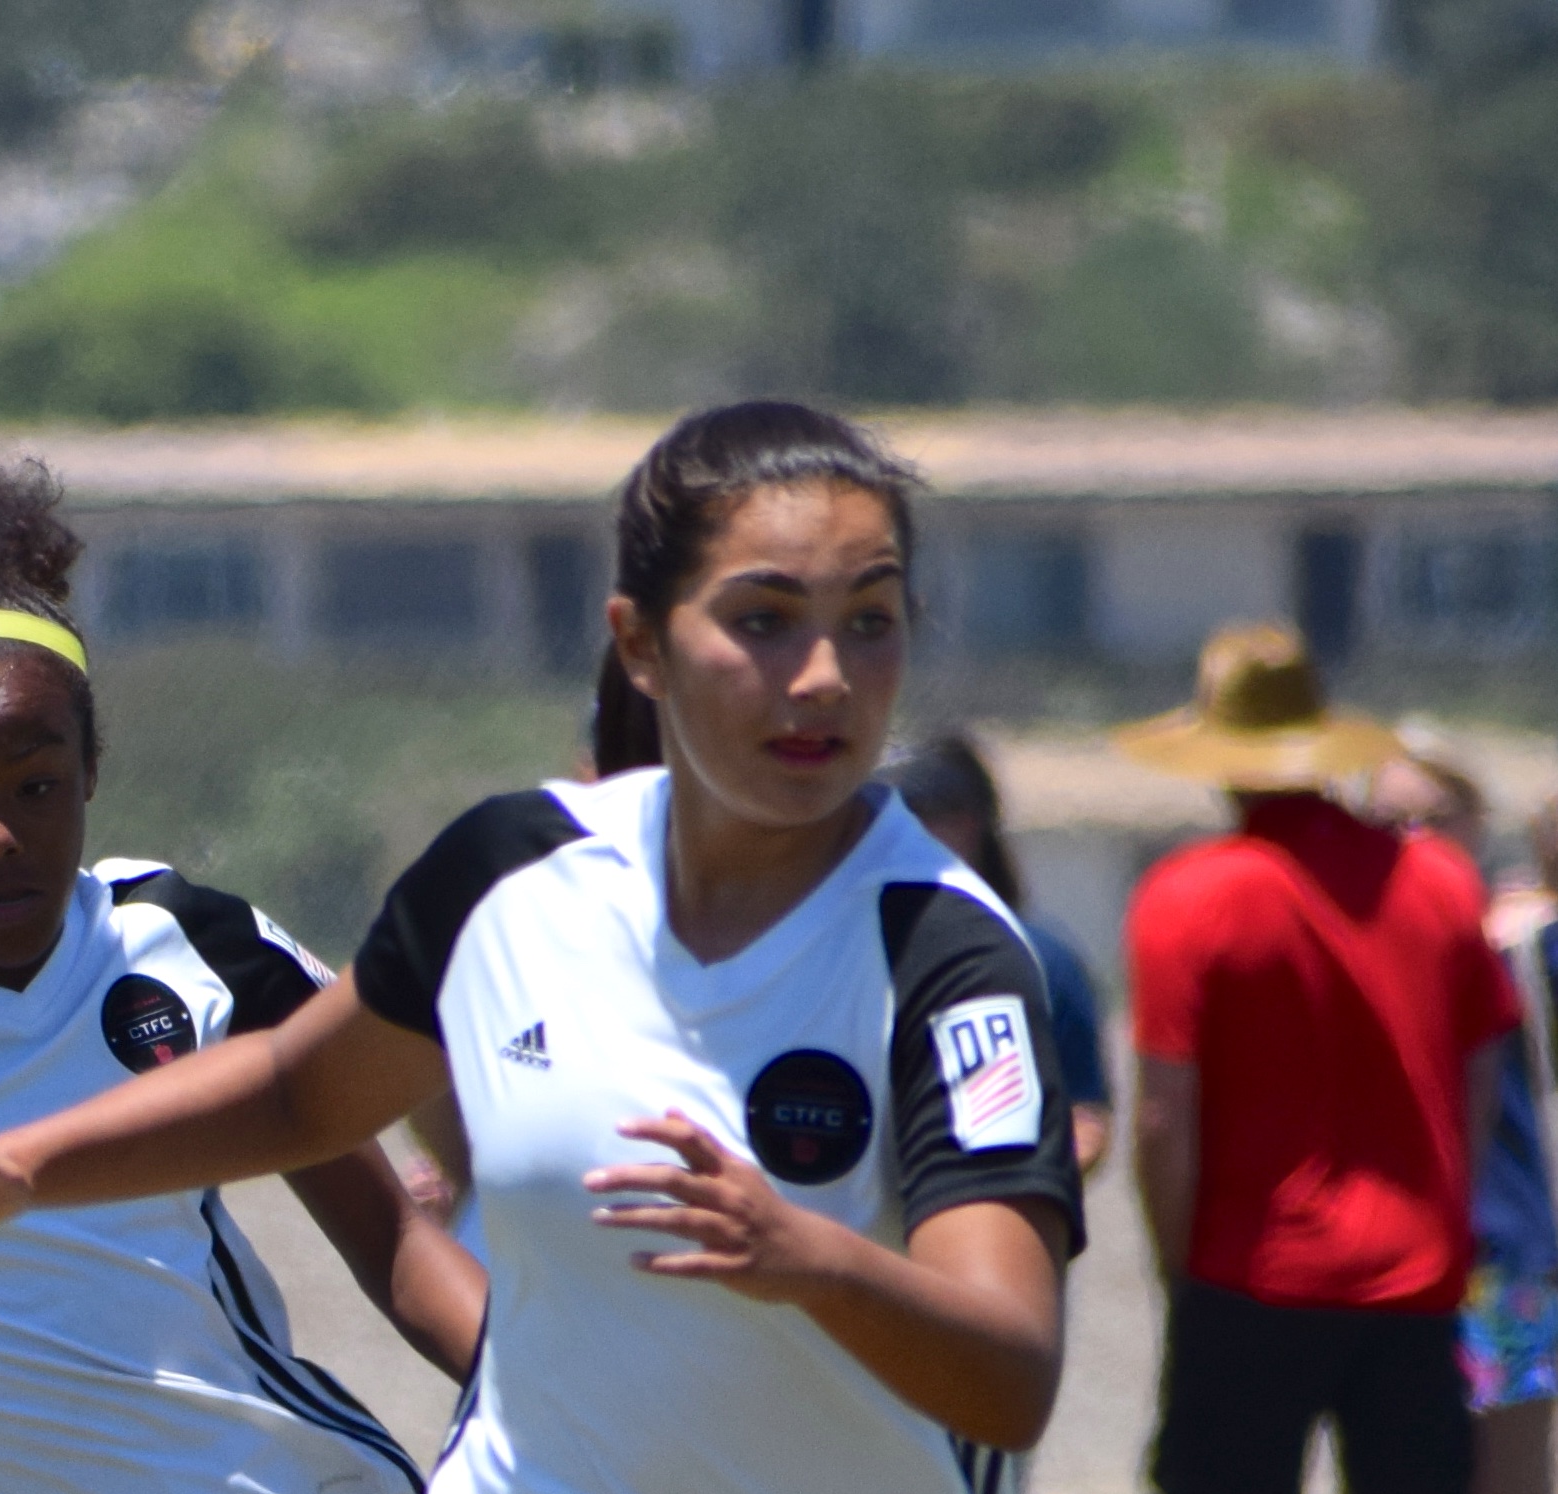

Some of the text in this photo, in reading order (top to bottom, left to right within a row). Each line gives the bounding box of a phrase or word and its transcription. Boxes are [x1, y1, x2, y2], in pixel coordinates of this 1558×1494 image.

[128, 1014, 173, 1040] CTFC
[949, 1013, 1015, 1078] DA
[774, 1103, 843, 1128] CTFC
